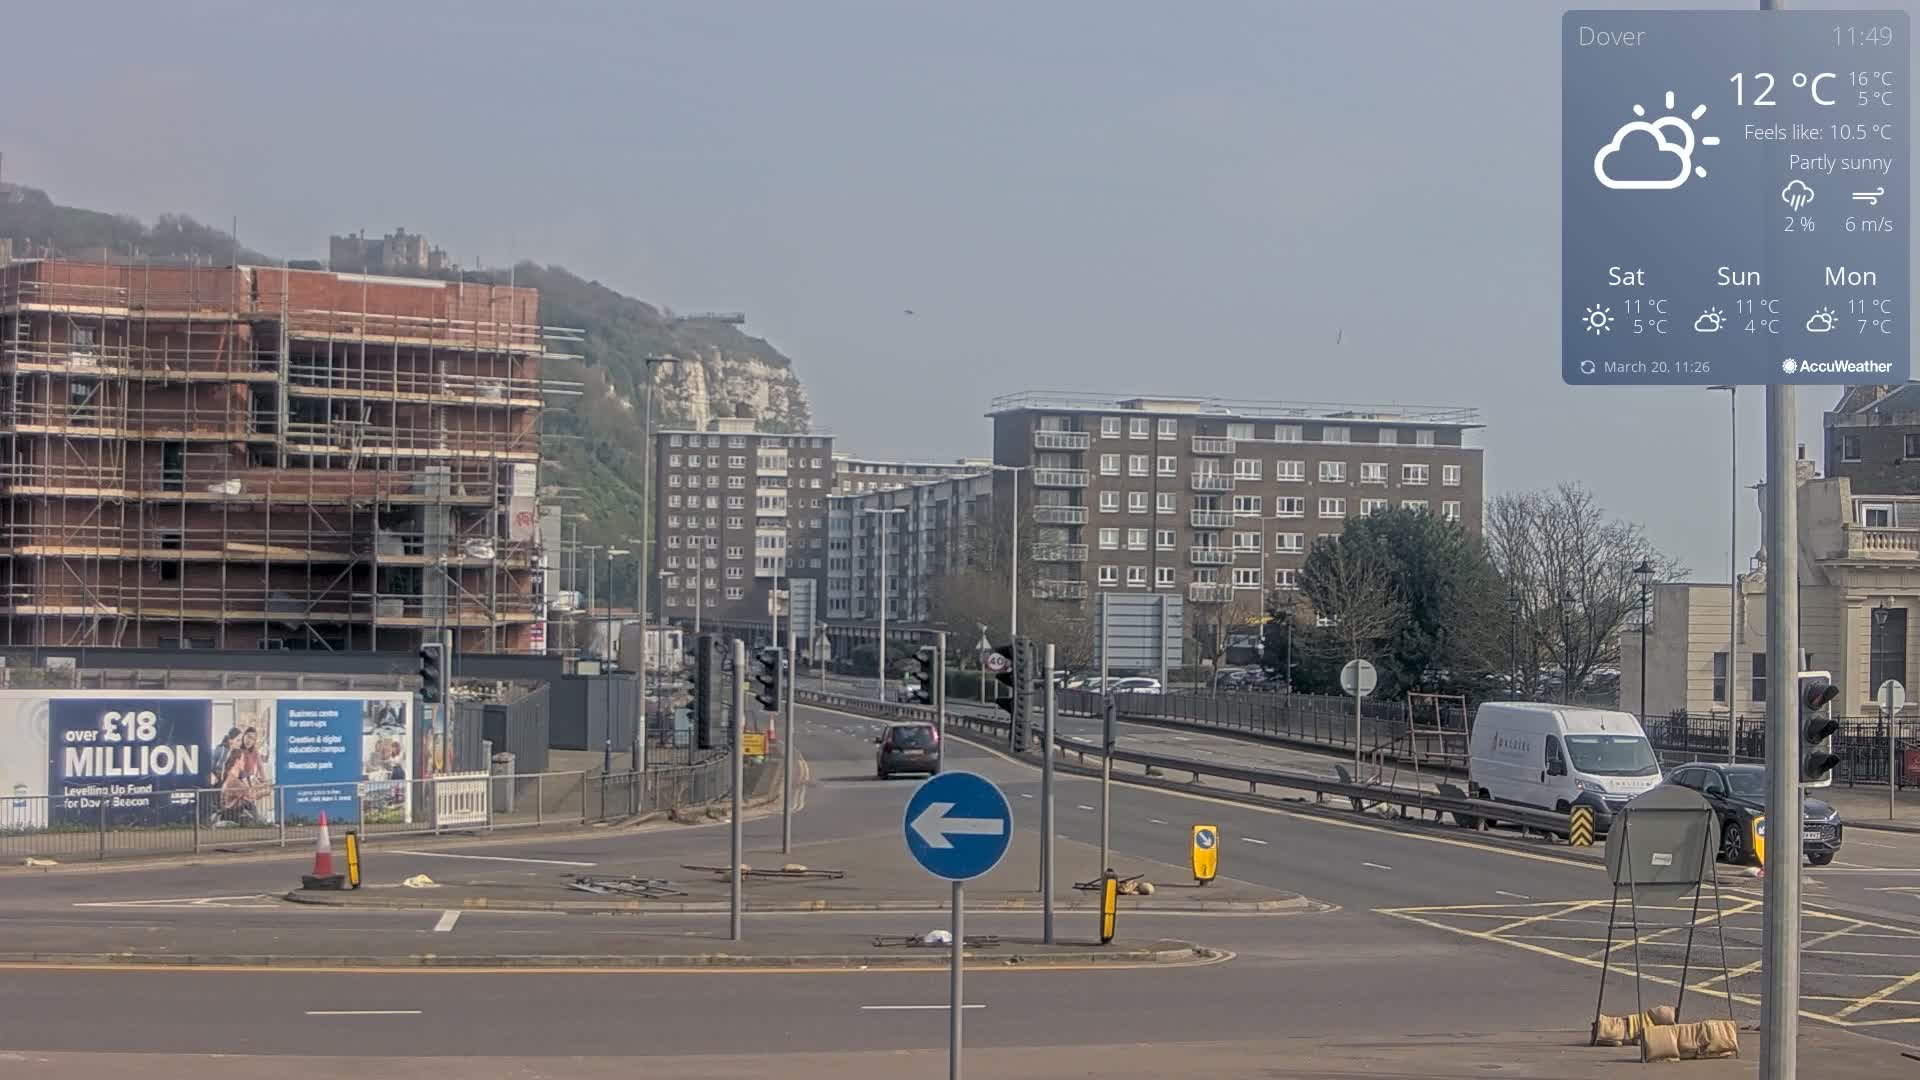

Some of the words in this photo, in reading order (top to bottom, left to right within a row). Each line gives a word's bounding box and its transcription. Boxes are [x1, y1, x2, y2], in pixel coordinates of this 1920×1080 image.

[991, 656, 1004, 665] 40
[288, 709, 318, 718] Business
[66, 730, 99, 742] over
[103, 711, 157, 742] £18
[288, 720, 298, 728] for
[299, 720, 328, 729] start-ups
[288, 735, 316, 743] Creative
[322, 735, 342, 745] digital
[288, 745, 320, 753] education
[320, 745, 346, 754] campus
[65, 745, 199, 777] MILLION
[288, 761, 317, 769] Riverside
[319, 761, 333, 771] park
[127, 784, 153, 796] Fund
[64, 798, 79, 809] for
[112, 796, 150, 807] Beacon
